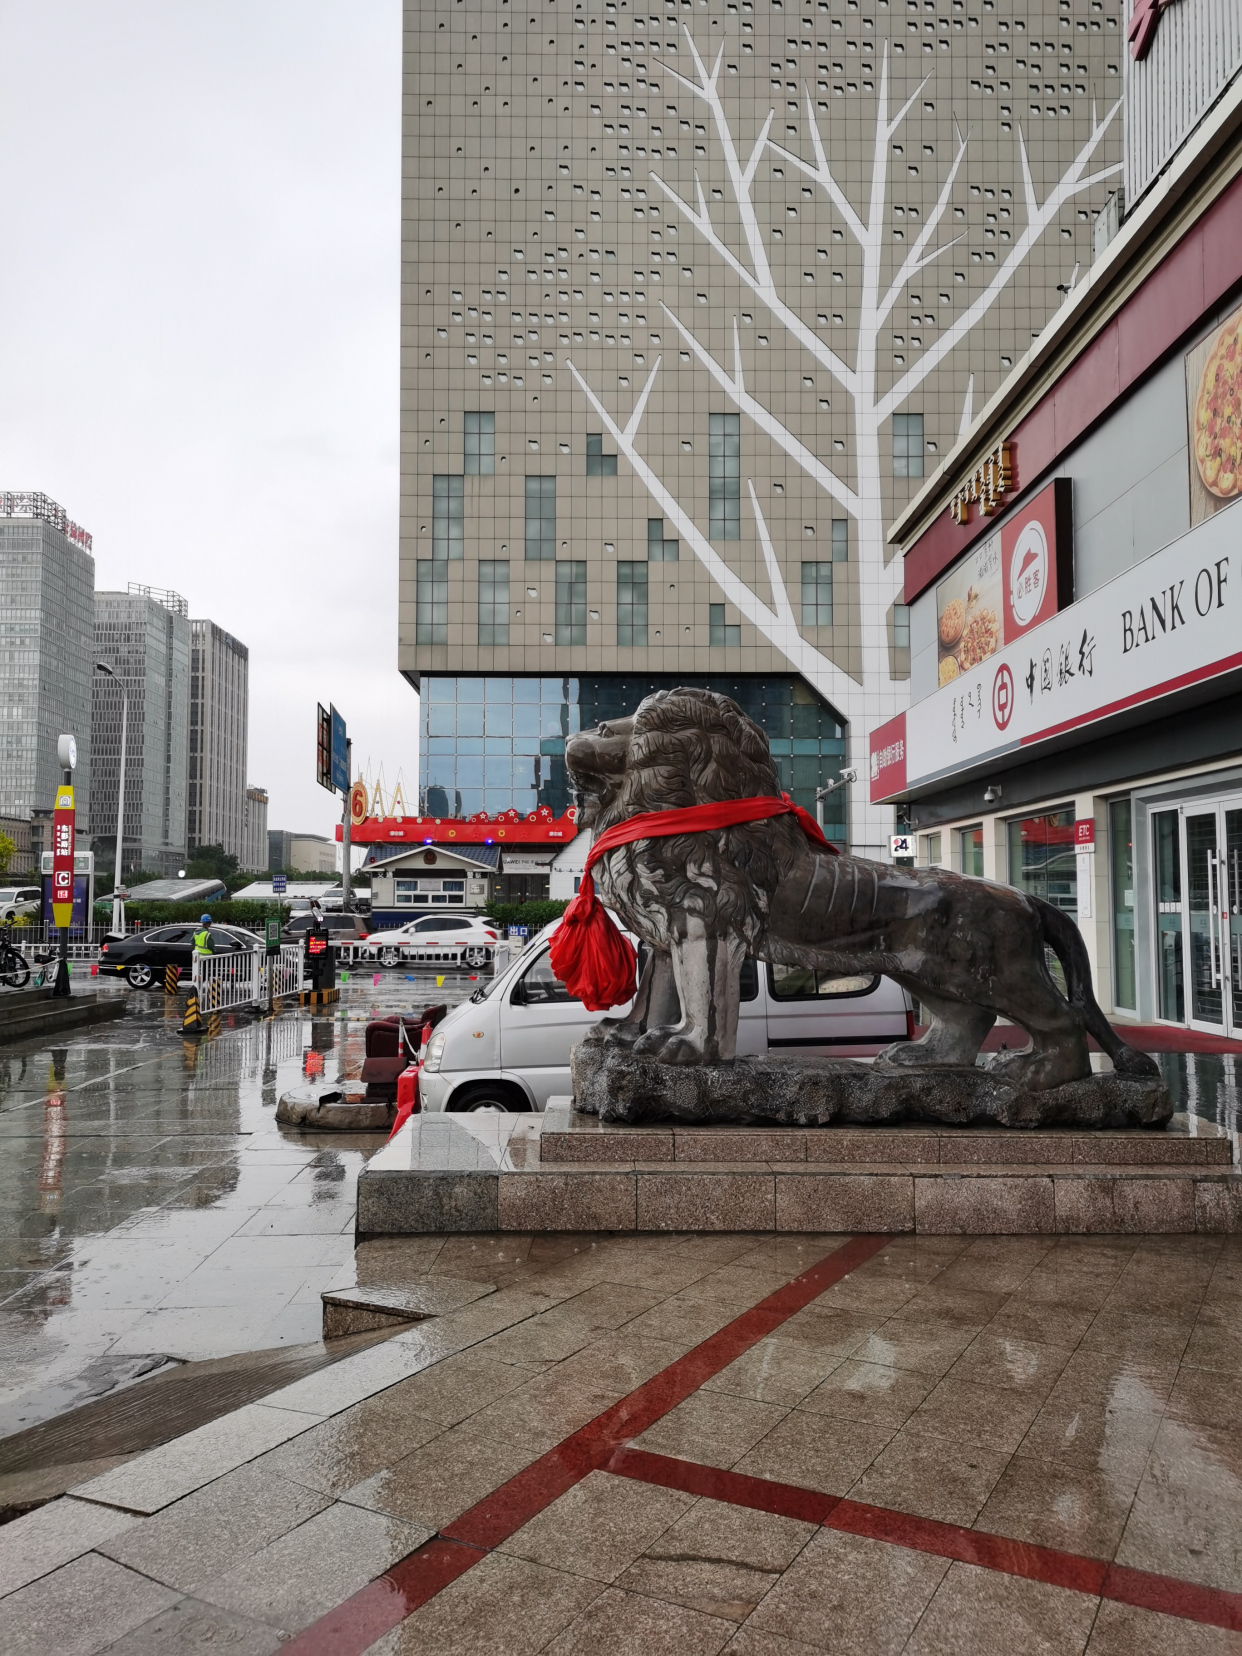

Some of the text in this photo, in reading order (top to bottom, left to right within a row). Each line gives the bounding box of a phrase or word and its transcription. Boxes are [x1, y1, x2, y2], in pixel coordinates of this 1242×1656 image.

[1017, 569, 1040, 599] 必胜客
[1121, 556, 1230, 654] BANK OF
[1078, 825, 1089, 837] ETC
[893, 838, 909, 851] 24
[58, 873, 69, 885] C
[509, 926, 528, 936] 出口
